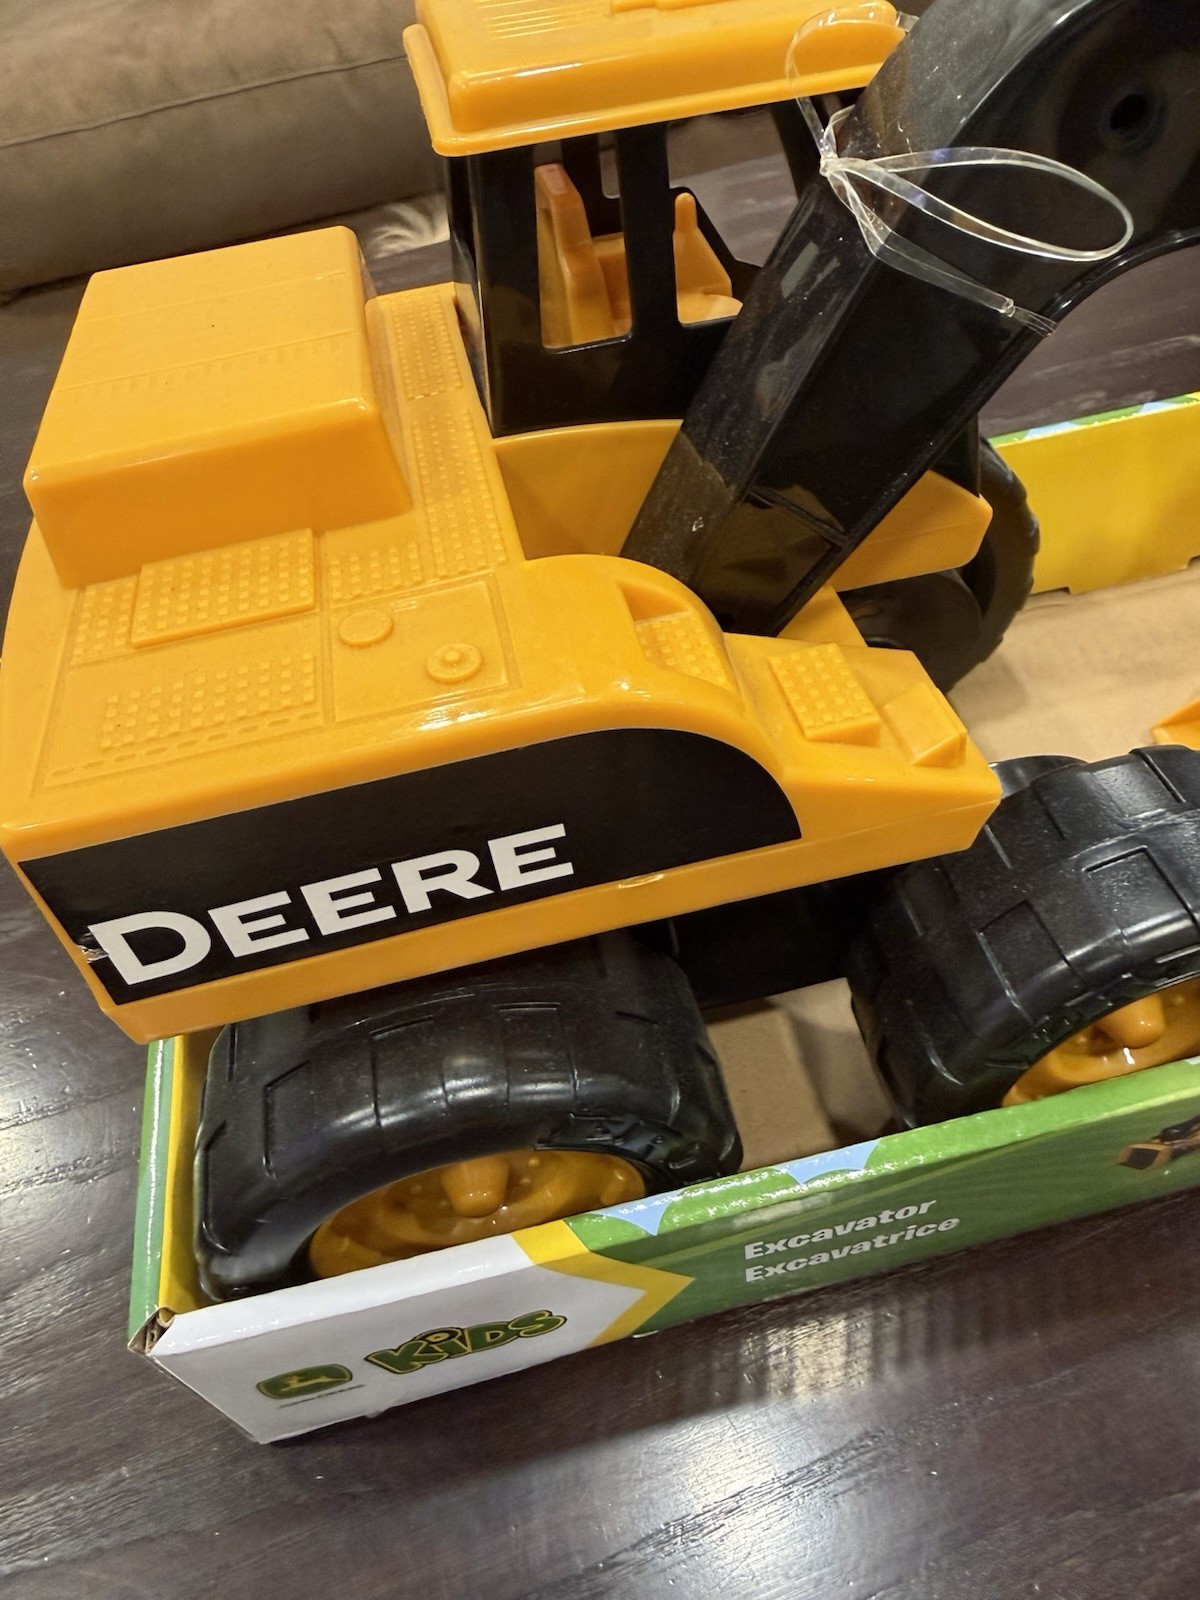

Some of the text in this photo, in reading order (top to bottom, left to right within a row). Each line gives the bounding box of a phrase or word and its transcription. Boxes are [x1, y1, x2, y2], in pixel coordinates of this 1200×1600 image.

[86, 823, 574, 986] DEERE
[744, 1199, 937, 1260] Excavator
[745, 1217, 961, 1283] Excavatrice
